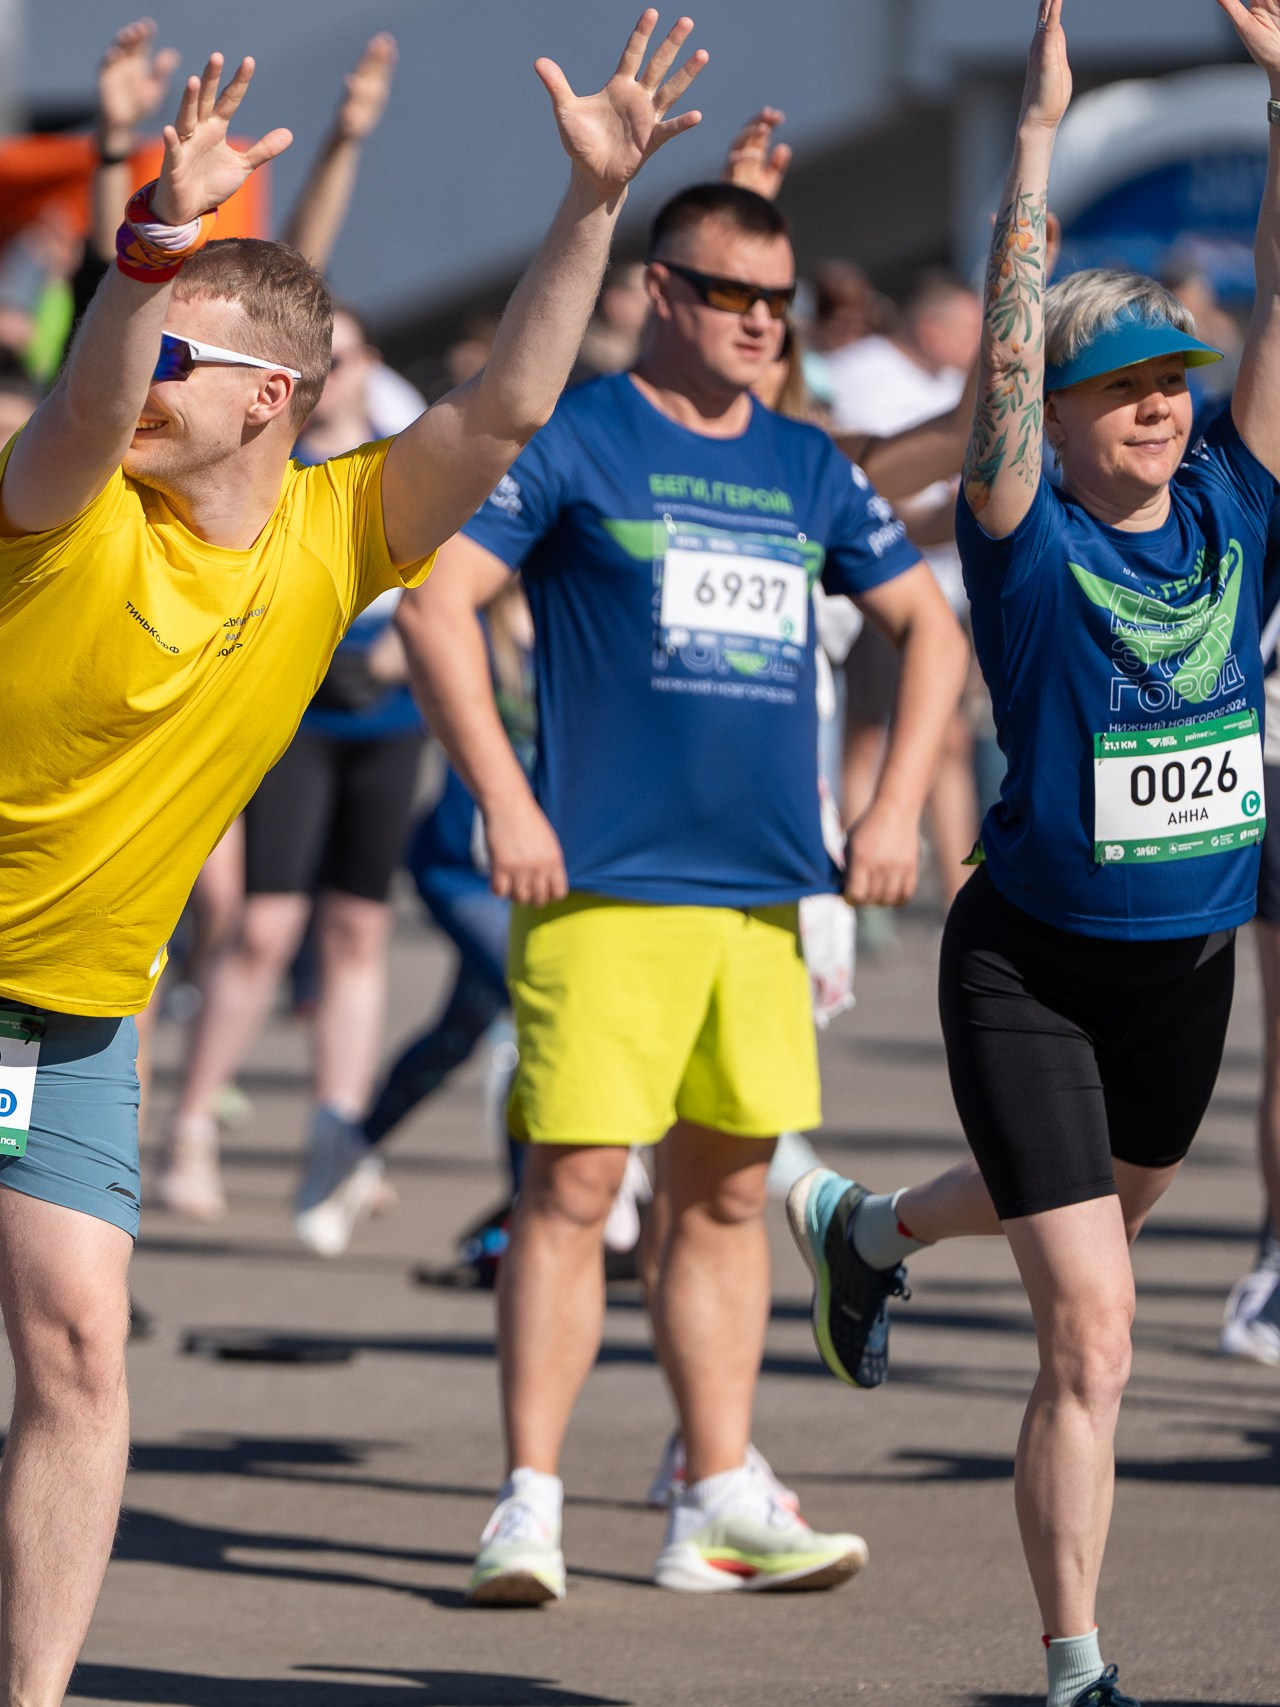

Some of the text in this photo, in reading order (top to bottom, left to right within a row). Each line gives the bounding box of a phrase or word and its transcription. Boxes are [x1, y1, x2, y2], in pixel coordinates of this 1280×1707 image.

[649, 473, 794, 513] БЕГИ, ГЕРОЙ
[694, 571, 787, 613] 6937
[1112, 613, 1232, 679] ЭТОТ
[1110, 654, 1246, 714] ГОРОД
[1109, 719, 1166, 732] НИЖНИЙ
[1169, 708, 1225, 729] НОВГОРОД
[1225, 697, 1247, 713] 2024
[1104, 740, 1120, 751] 21,1
[1130, 751, 1238, 806] 0026
[1167, 807, 1209, 825] АННА
[0, 1137, 17, 1146] ПСБ
